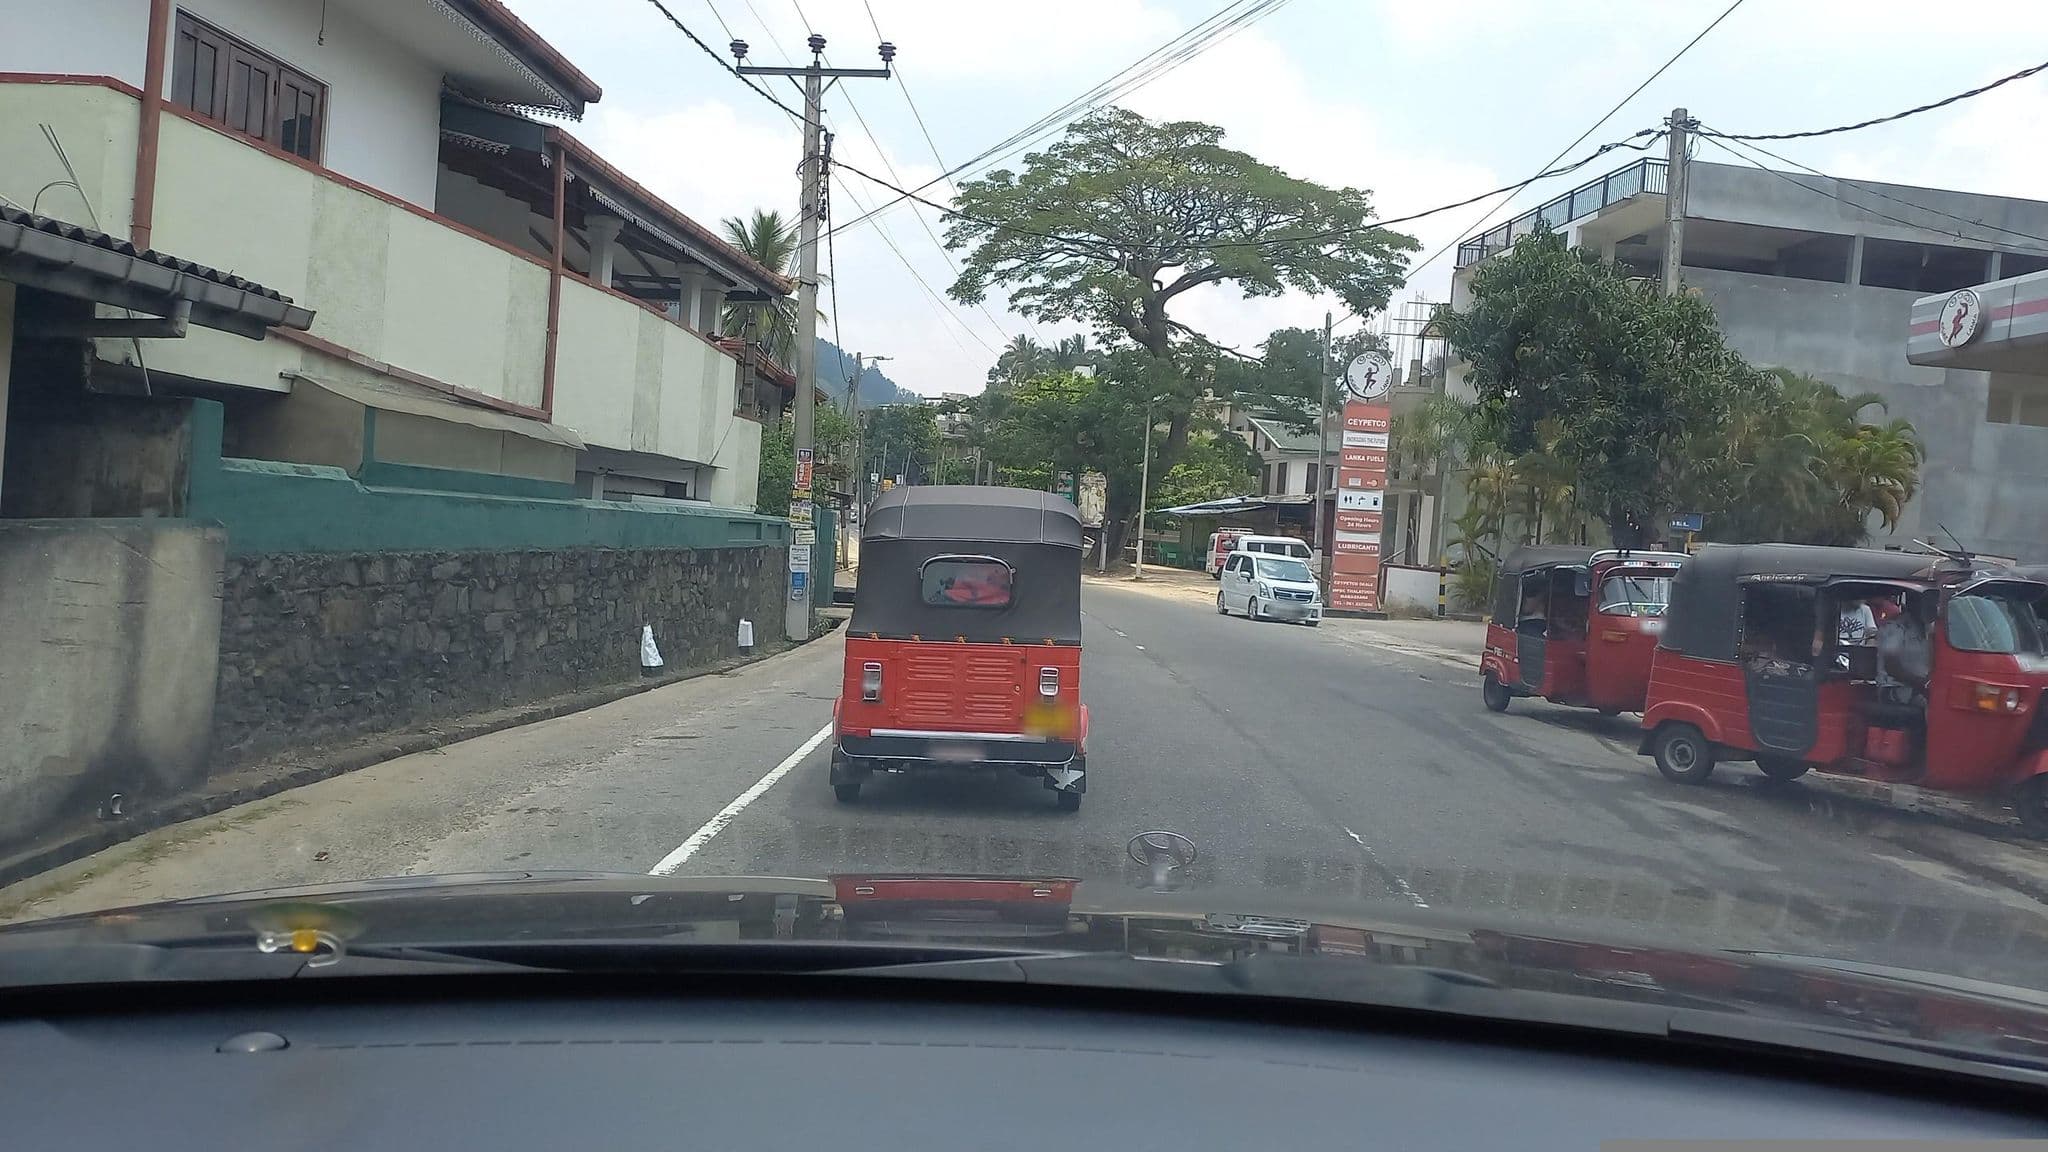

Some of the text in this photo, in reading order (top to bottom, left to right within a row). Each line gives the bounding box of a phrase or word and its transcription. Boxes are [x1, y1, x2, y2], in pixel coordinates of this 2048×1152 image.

[1347, 418, 1387, 428] CEYPETCO
[1366, 455, 1385, 463] FUELS
[1339, 515, 1363, 523] Opening
[1338, 543, 1378, 551] LUBRICANTS
